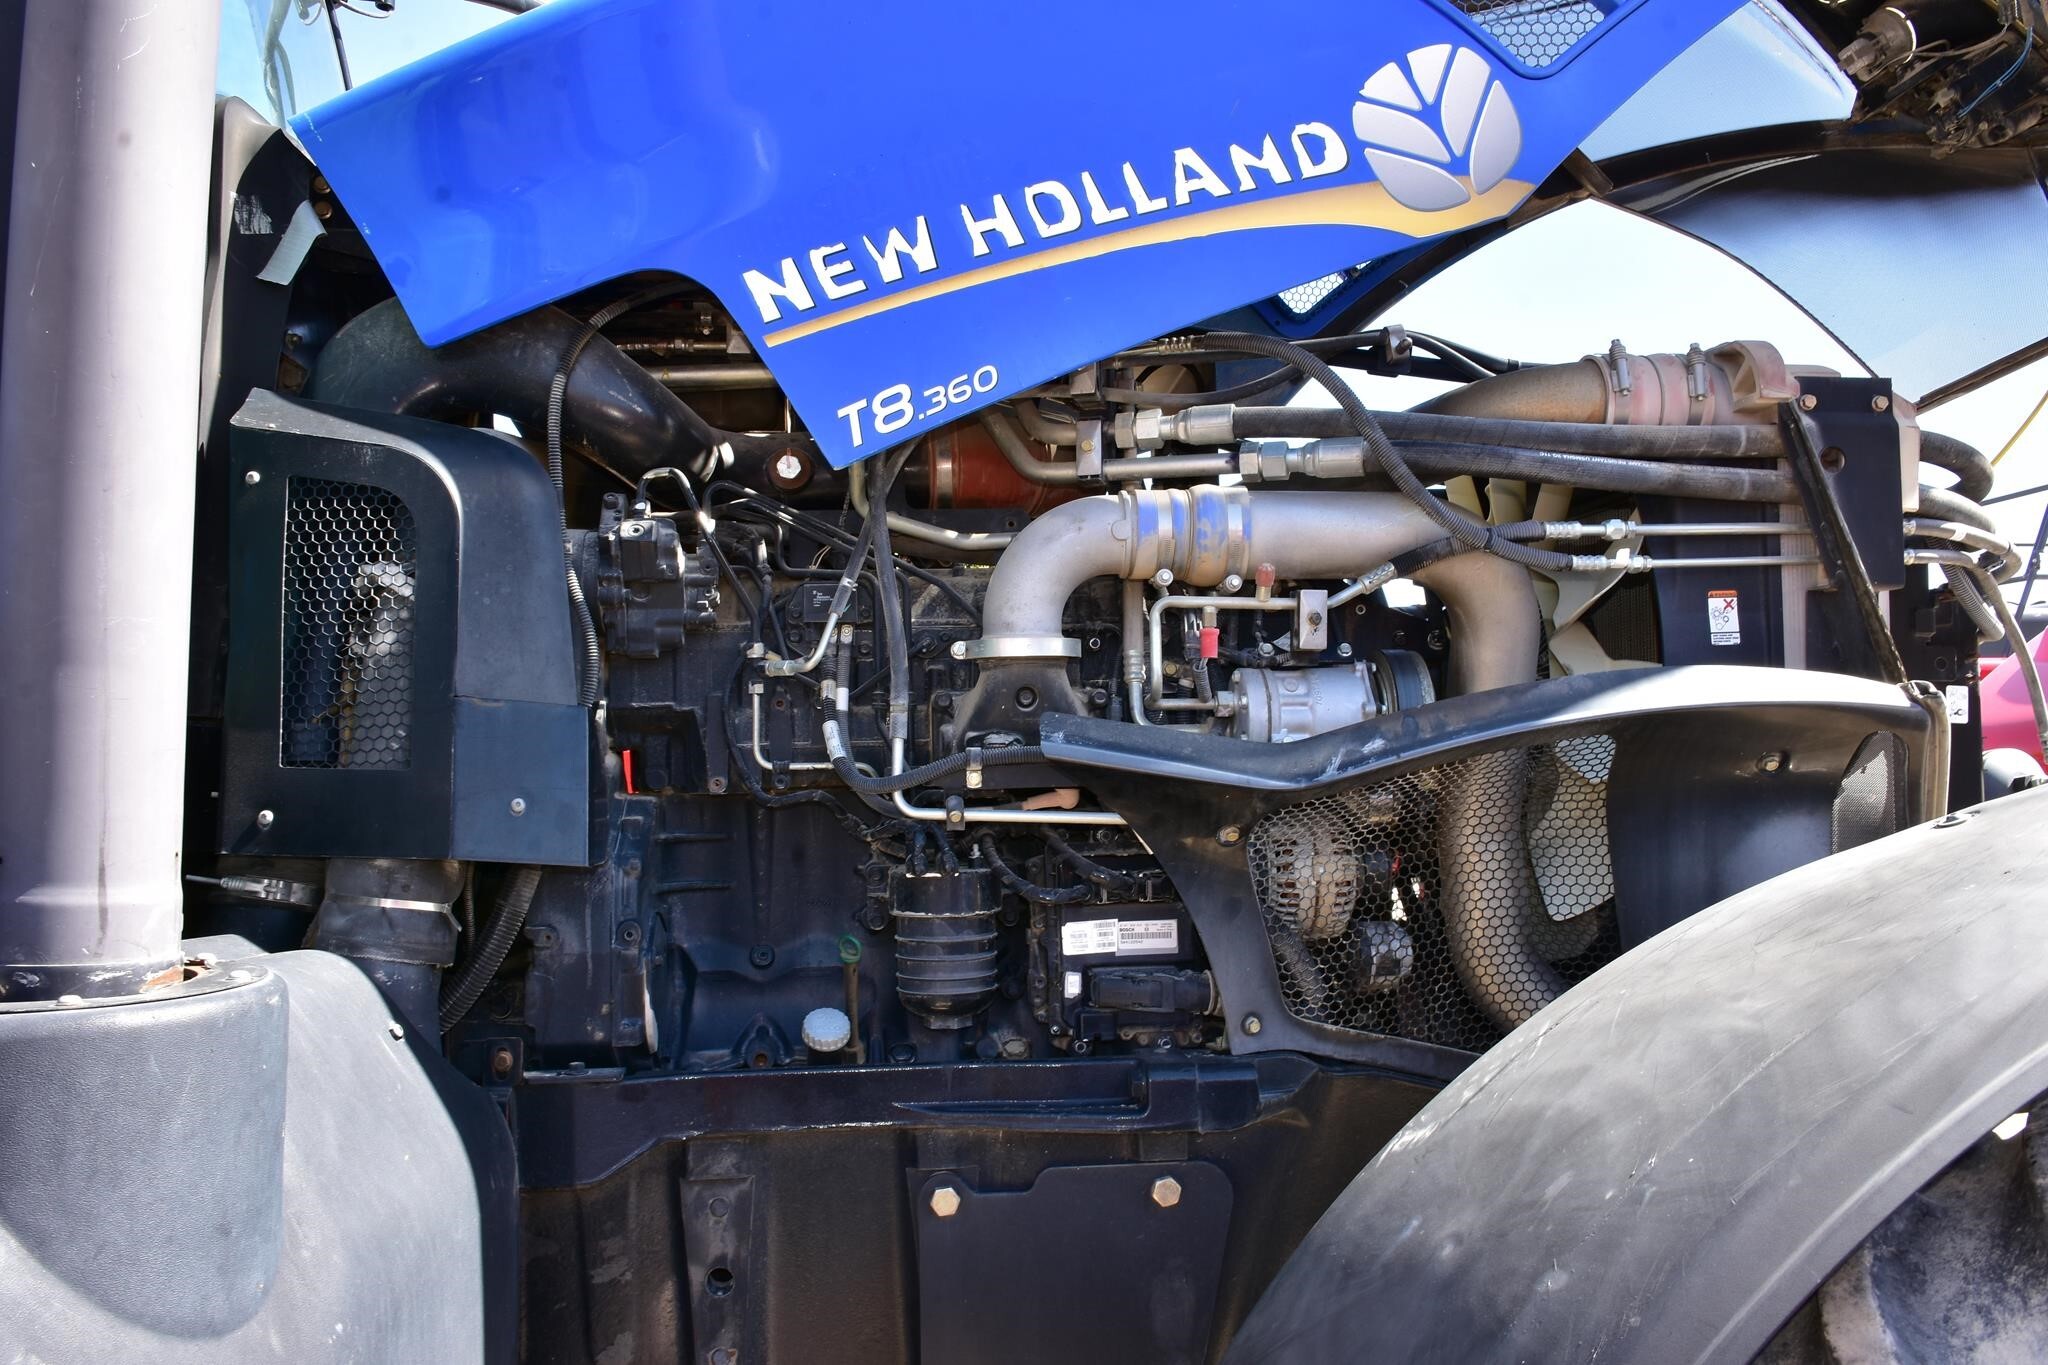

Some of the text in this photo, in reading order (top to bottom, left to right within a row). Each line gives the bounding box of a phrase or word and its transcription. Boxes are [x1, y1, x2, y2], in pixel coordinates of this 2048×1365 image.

[742, 122, 1349, 324] NEW HOLLAND
[837, 364, 1000, 449] T8.360
